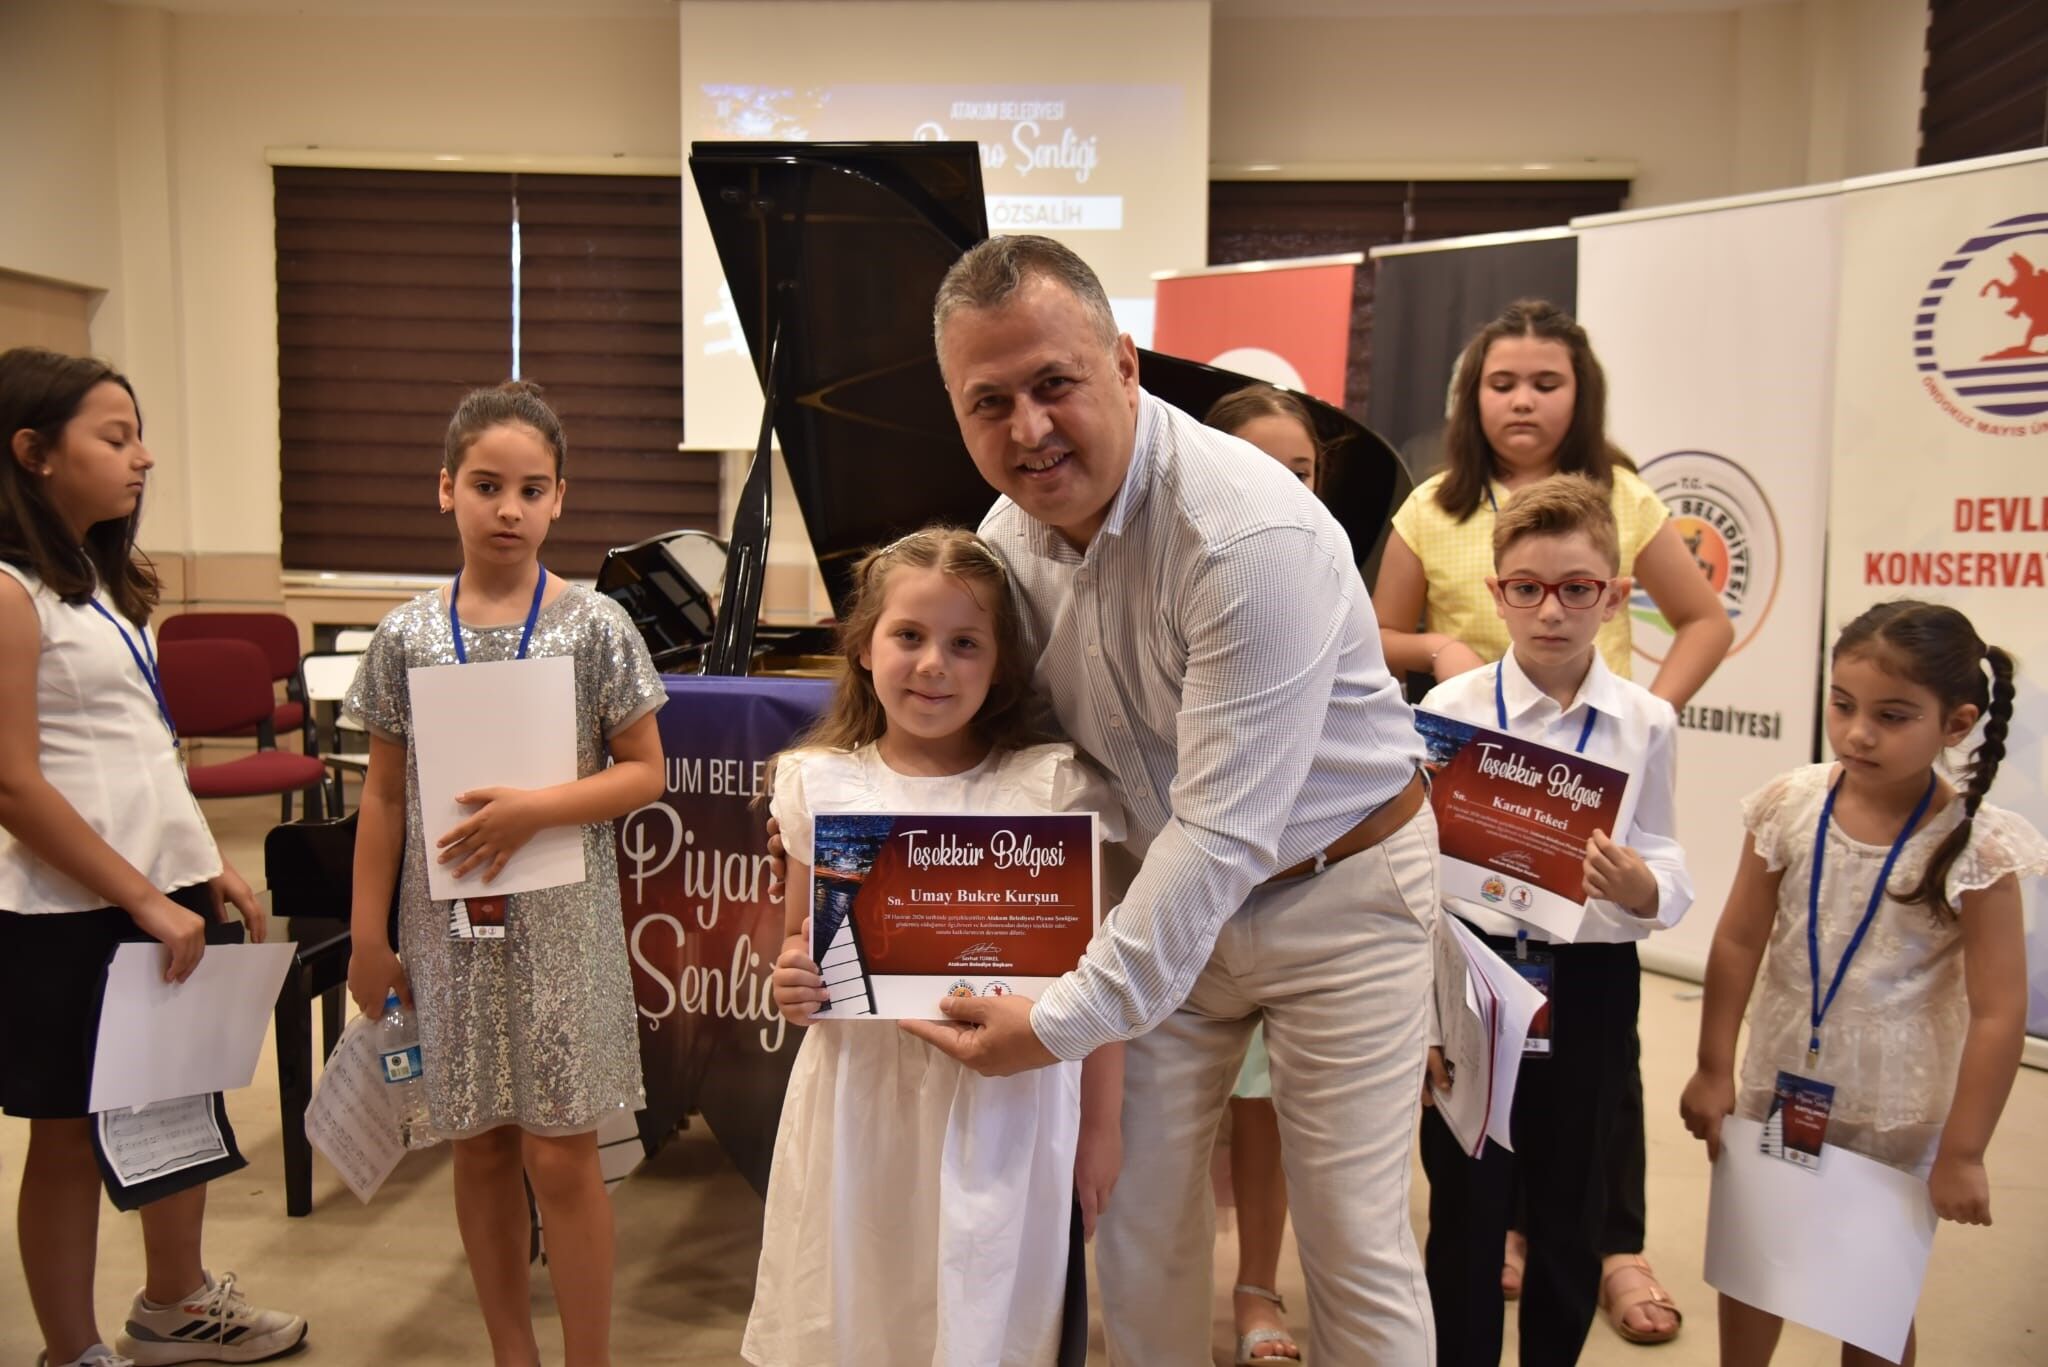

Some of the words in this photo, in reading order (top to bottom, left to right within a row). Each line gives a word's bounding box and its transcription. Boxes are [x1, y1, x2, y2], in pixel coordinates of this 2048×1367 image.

[1977, 421, 2027, 437] MAYIS
[1865, 552, 2048, 588] KONSERVA
[1678, 704, 1782, 740] ELEDİYESİ
[709, 758, 774, 796] BELE
[1476, 742, 1543, 787] Teşekkür
[1546, 763, 1604, 812] Belgesi
[1492, 796, 1532, 818] Kartal
[1533, 808, 1569, 831] Tekeci
[622, 801, 784, 930] Piyan
[898, 829, 984, 871] Teşekkür
[990, 829, 1066, 878] Belgesi
[887, 896, 904, 906] Sn.
[911, 888, 953, 905] Umay
[957, 889, 1001, 902] Bukre
[1005, 889, 1059, 905] Kurşun
[630, 913, 786, 1053] Şenliğ
